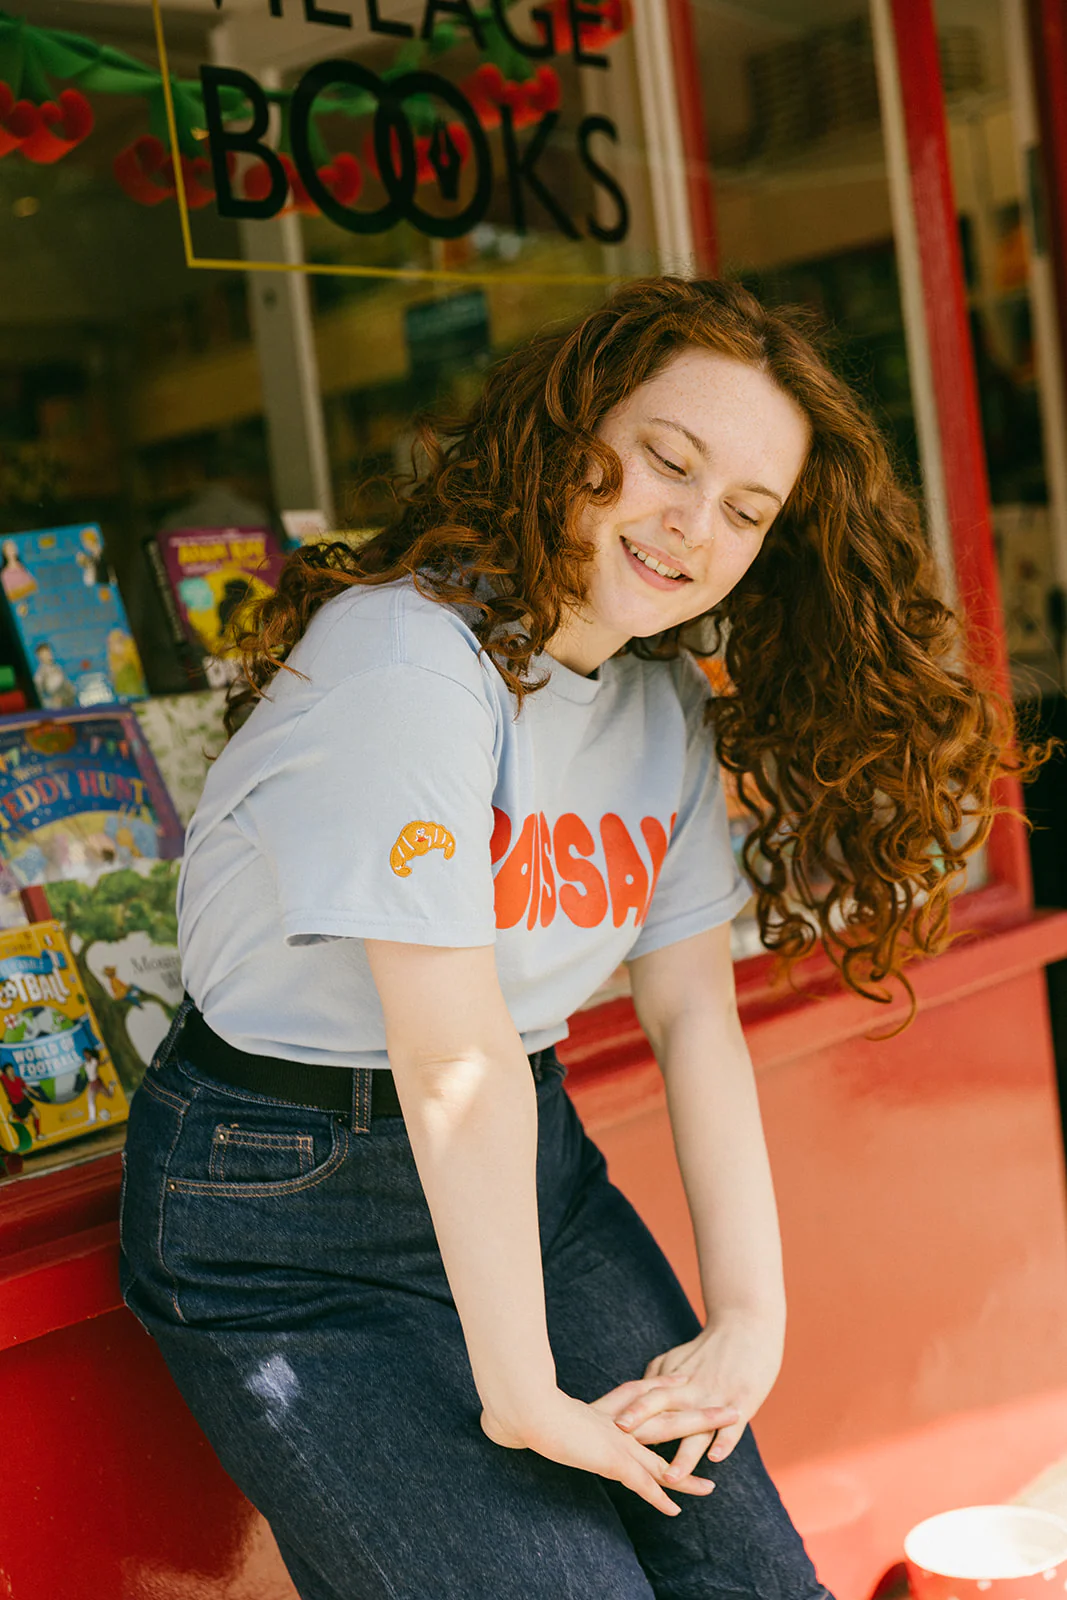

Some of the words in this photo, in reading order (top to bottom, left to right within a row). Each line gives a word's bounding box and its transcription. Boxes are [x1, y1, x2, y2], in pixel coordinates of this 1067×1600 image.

[200, 59, 630, 243] BOOKS
[0, 771, 72, 829] EDDY
[77, 769, 147, 804] HUNT
[12, 1042, 59, 1063] WORLD
[19, 1049, 82, 1077] FOOTBALL
